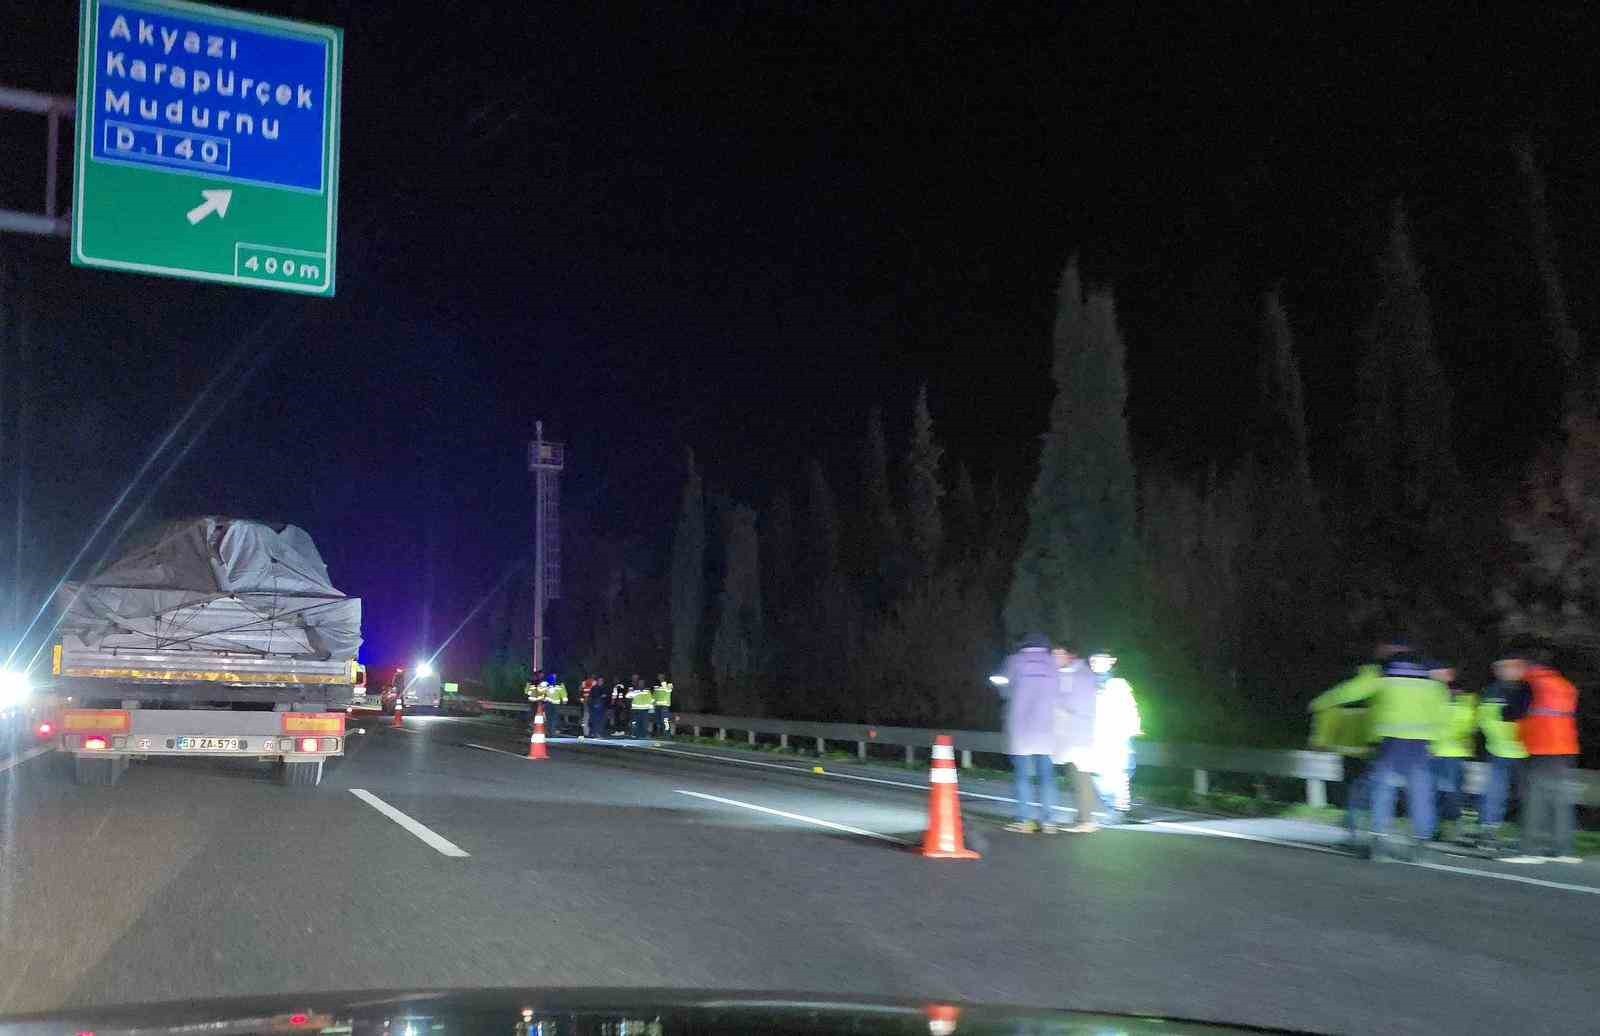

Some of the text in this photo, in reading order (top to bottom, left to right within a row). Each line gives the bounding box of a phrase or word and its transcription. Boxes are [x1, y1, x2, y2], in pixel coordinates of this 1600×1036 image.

[109, 15, 237, 60] Akyazı
[105, 88, 279, 140] Mudurnu
[116, 127, 219, 163] D.140
